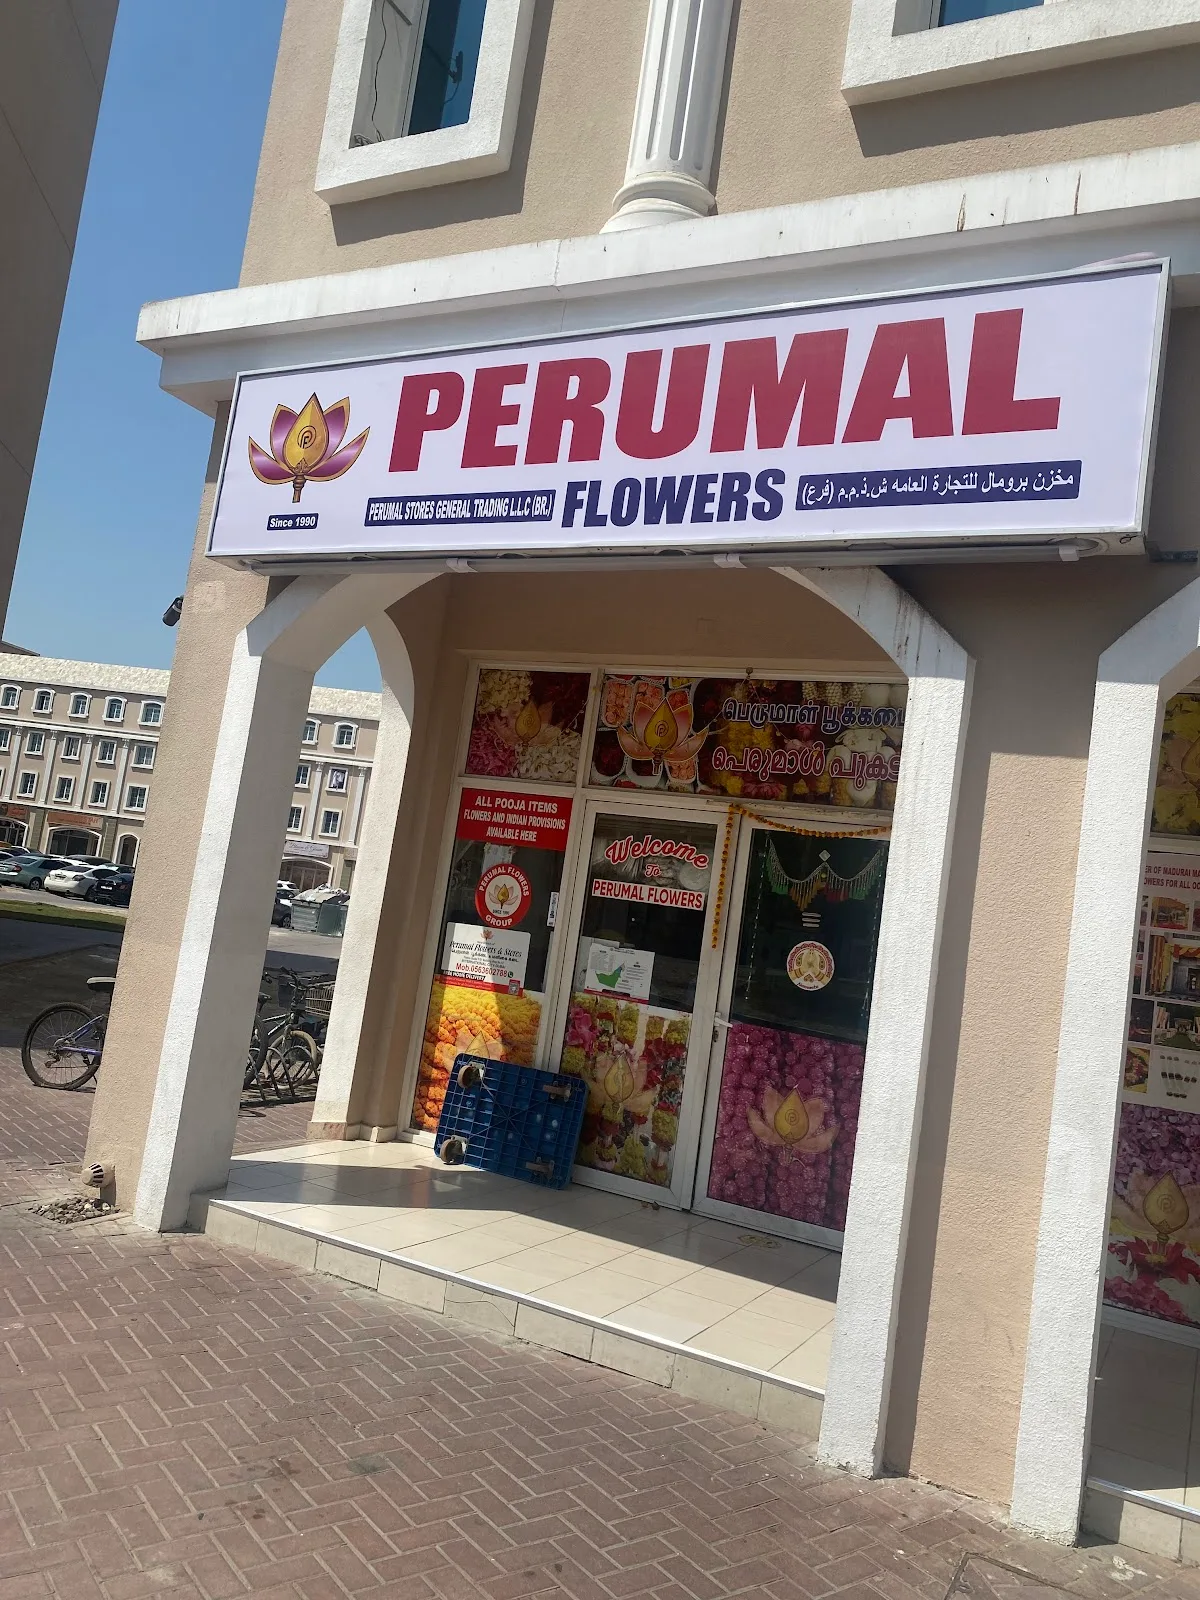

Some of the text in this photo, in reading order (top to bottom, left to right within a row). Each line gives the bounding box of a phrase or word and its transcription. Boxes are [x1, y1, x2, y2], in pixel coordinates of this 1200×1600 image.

[389, 308, 1060, 472] PERUMAL
[932, 473, 978, 496] للتجارة
[982, 472, 1028, 493] برومال
[1033, 471, 1073, 491] مخزن
[561, 469, 784, 528] FLOWERS
[802, 481, 834, 505] (فرع)
[368, 494, 552, 520] PERUMAL STORES GENERAL TRADING L.L.C (BR.)
[270, 516, 316, 527] Since 1990
[723, 697, 819, 729] பெருமாள்
[475, 796, 558, 814] ALL POOJA ITEMS
[464, 809, 566, 830] FLOWERS AND INDIAN PROVISIONS
[486, 826, 537, 842] AVAILABLE HERE
[605, 835, 709, 869] Welcome
[479, 866, 529, 896] PERUMAL FLOWERS
[645, 864, 661, 877] To
[1154, 866, 1161, 874] OF
[1163, 867, 1190, 877] MADURAI
[593, 880, 703, 909] PERUMAL FLOWERS
[1166, 879, 1177, 888] FOR
[1179, 880, 1190, 889] ALL
[485, 914, 513, 927] GROUP
